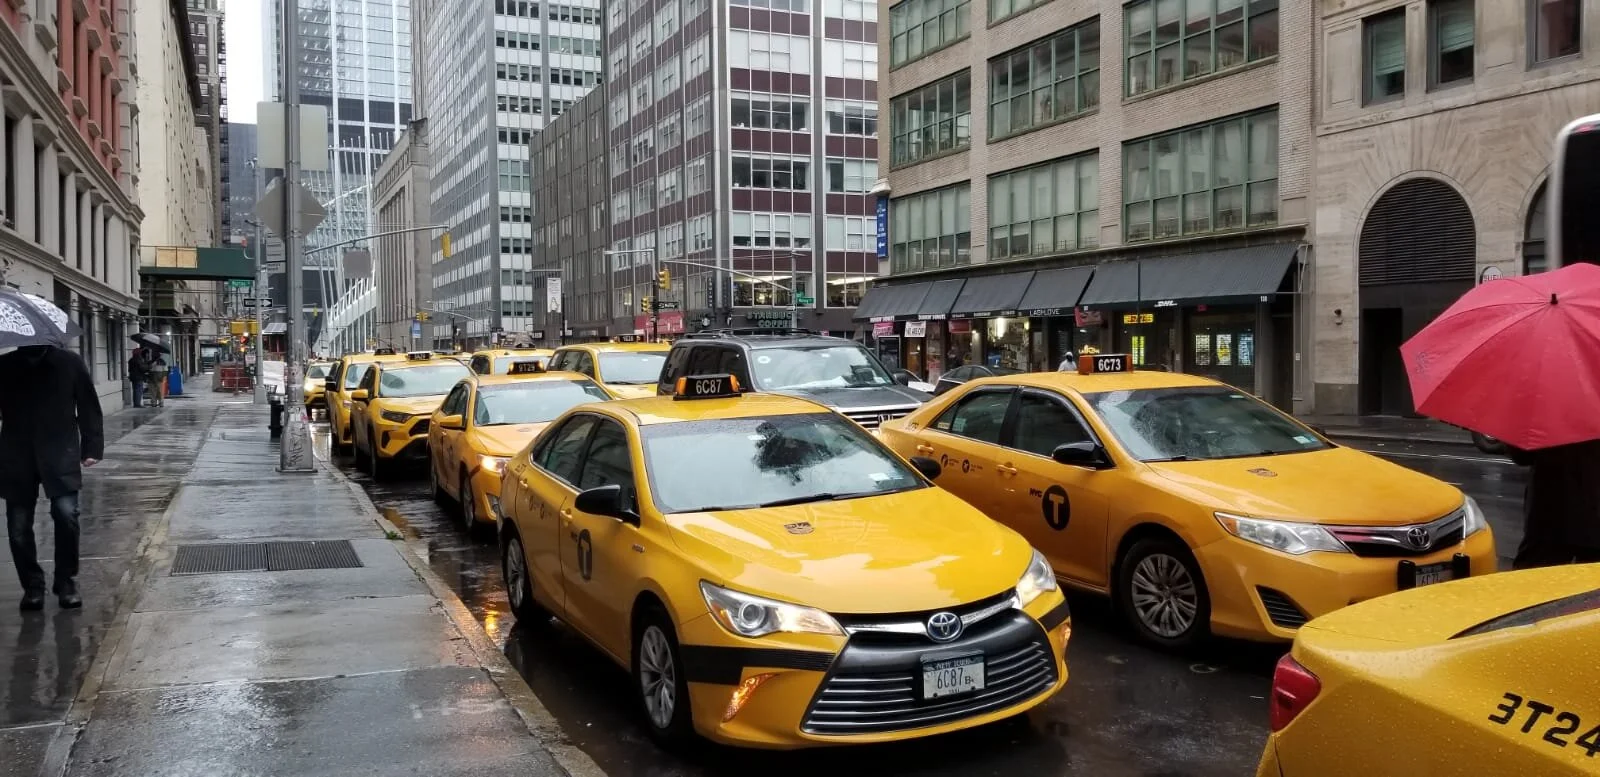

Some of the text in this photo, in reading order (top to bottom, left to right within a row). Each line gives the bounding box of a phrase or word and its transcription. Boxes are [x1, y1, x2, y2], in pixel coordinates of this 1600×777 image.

[747, 311, 805, 320] STARBUCS
[1098, 358, 1121, 371] 6C73
[696, 379, 722, 394] 6C87
[1029, 487, 1043, 498] NYC
[937, 667, 964, 689] 6C87
[1487, 692, 1600, 758] 3T24
